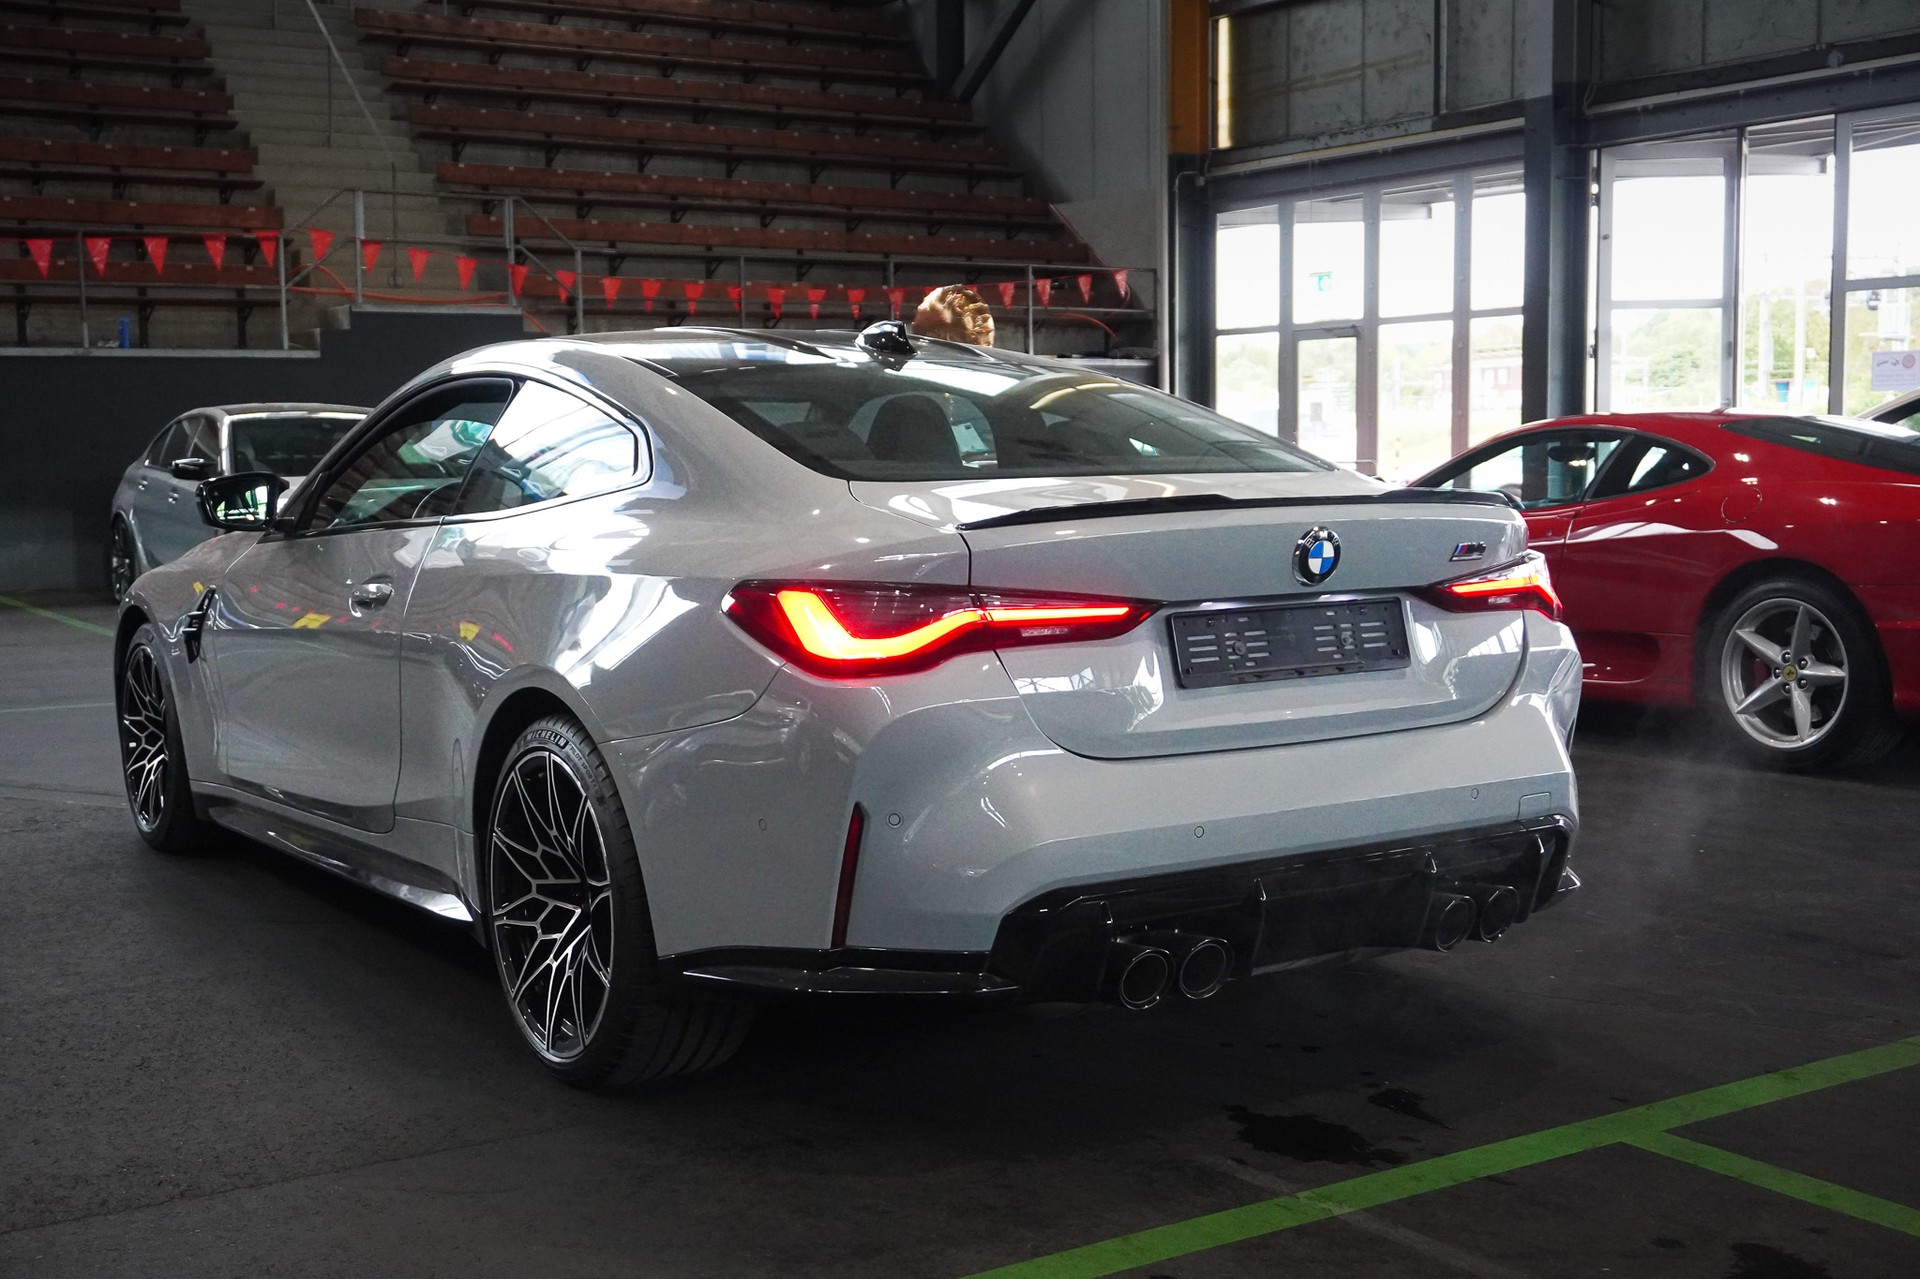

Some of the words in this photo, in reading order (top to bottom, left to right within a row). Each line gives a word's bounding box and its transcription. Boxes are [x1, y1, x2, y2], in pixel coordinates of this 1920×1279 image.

[1304, 530, 1340, 548] BMW
[526, 730, 567, 747] MICHELIN
[569, 746, 583, 761] PILOT
